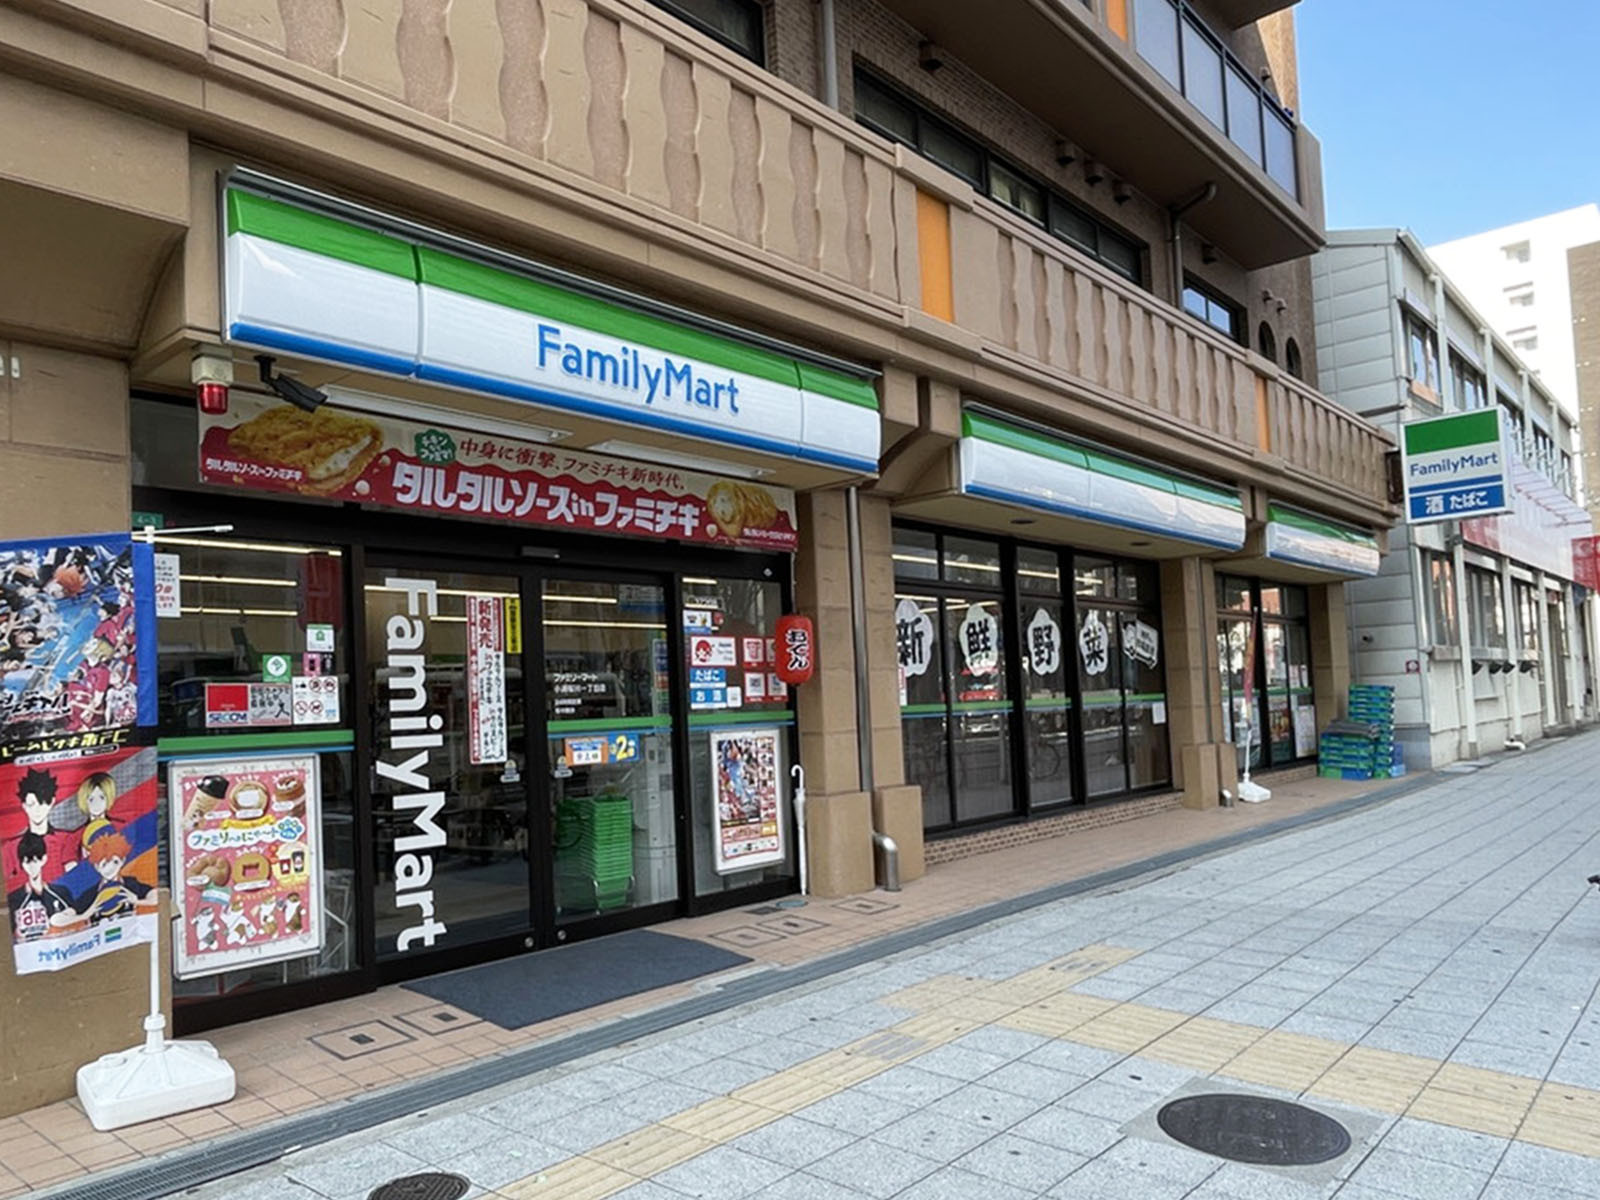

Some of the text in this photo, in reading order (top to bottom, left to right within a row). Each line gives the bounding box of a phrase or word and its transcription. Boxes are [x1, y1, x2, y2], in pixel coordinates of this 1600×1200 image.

[537, 323, 739, 414] FamilyMart
[1410, 452, 1498, 476] FamilyMart
[1425, 491, 1488, 515] 酒 たばこ
[479, 599, 493, 649] 新発売
[1033, 624, 1055, 667] 野
[1083, 626, 1105, 667] 菜
[376, 577, 447, 952] FamilyMart
